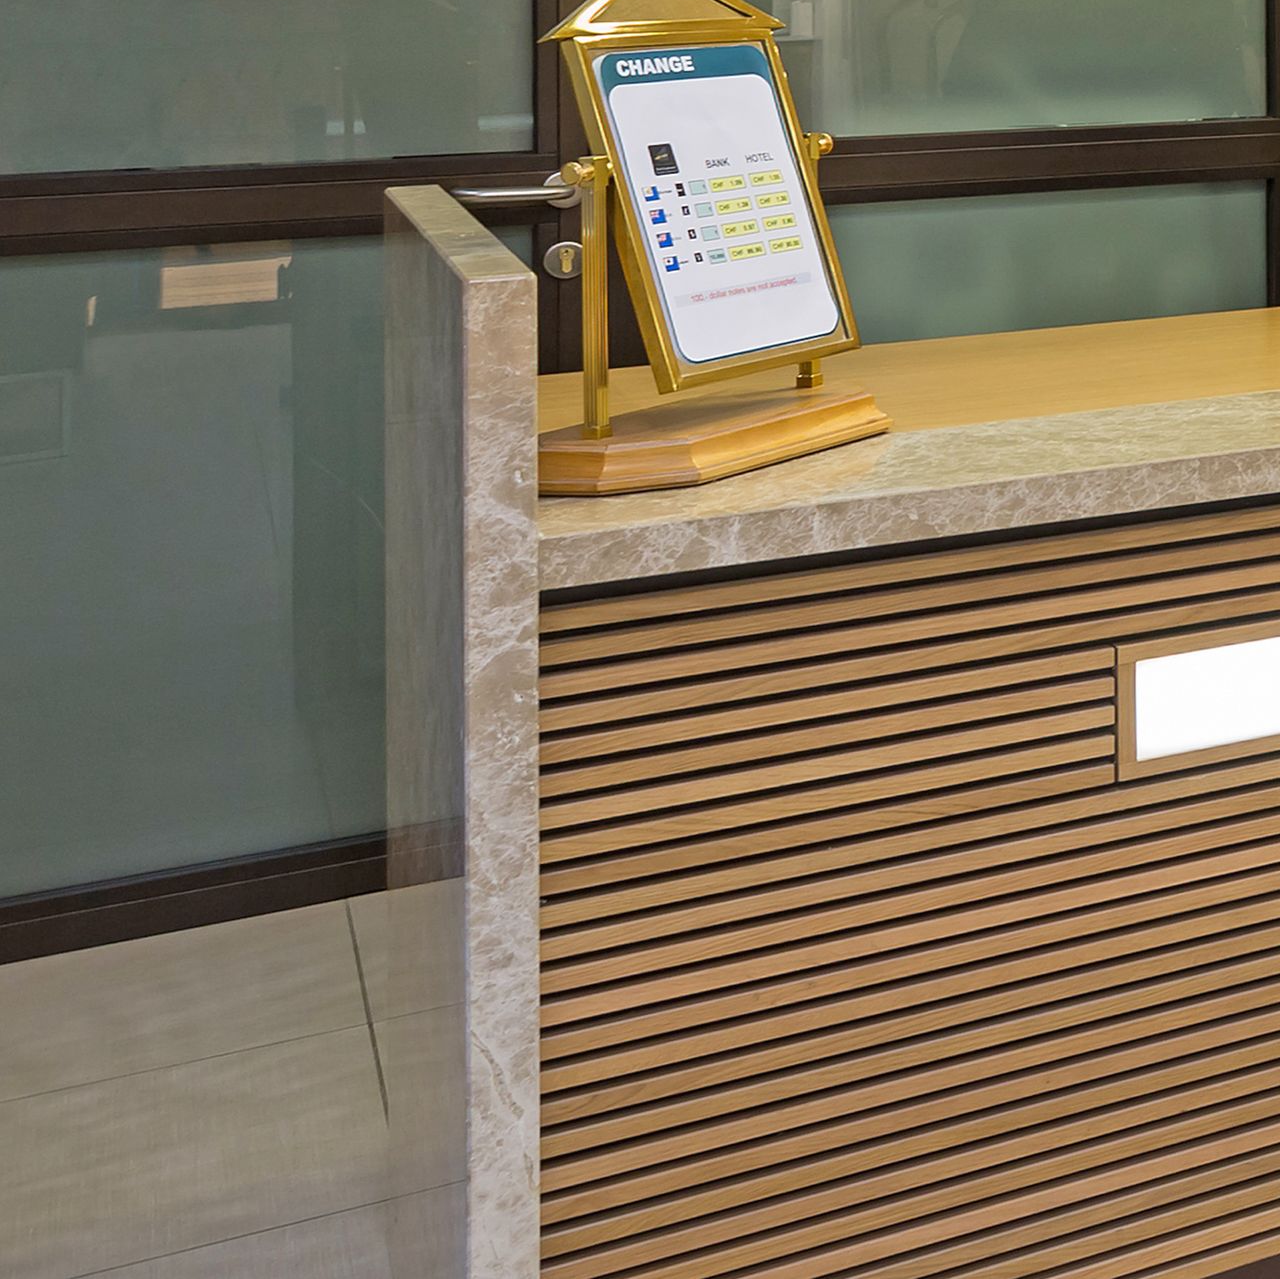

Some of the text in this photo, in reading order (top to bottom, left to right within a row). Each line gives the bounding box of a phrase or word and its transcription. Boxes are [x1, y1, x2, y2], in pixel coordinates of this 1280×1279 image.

[615, 55, 695, 77] CHANGE
[705, 152, 774, 169] BANK HOTEL
